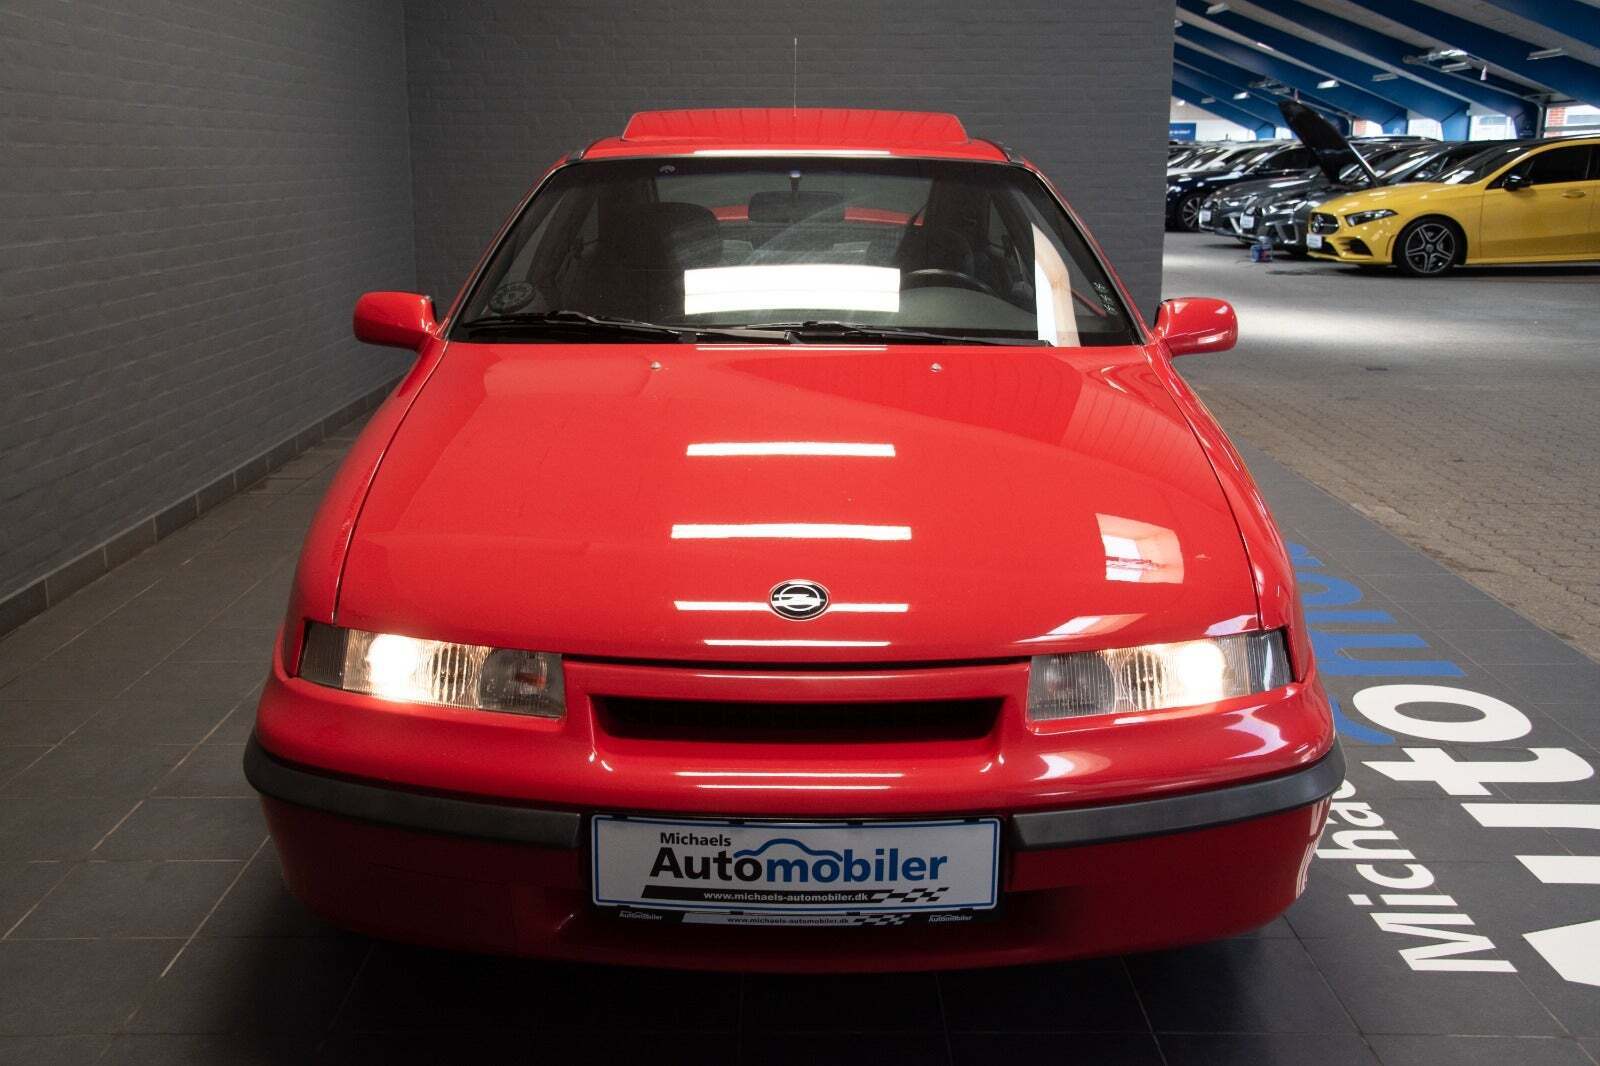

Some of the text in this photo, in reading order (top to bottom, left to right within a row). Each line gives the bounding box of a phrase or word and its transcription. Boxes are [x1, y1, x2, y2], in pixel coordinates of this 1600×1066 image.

[660, 832, 732, 847] Michaels
[649, 847, 948, 883] Automobiler
[703, 892, 869, 902] www.michaels-automobiler.dk
[727, 916, 849, 925] www.michaels-automobiler.dk
